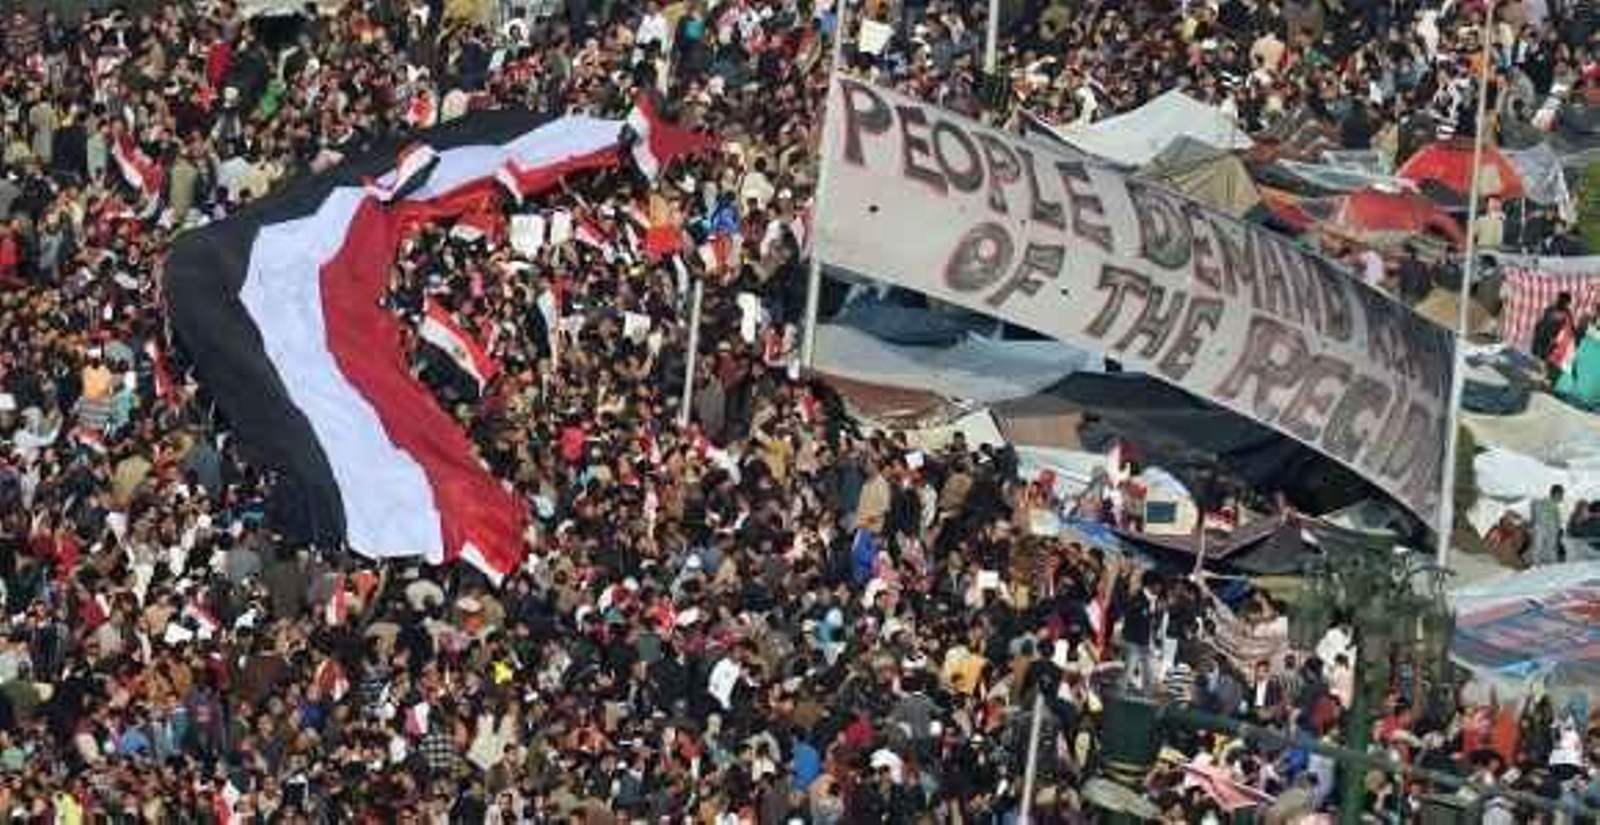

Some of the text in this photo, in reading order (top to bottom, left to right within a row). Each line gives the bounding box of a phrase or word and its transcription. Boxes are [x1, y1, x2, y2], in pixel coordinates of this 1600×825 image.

[838, 78, 1354, 343] PEOPLE DEMAND
[944, 220, 1065, 306] OF
[1084, 264, 1226, 381] THE
